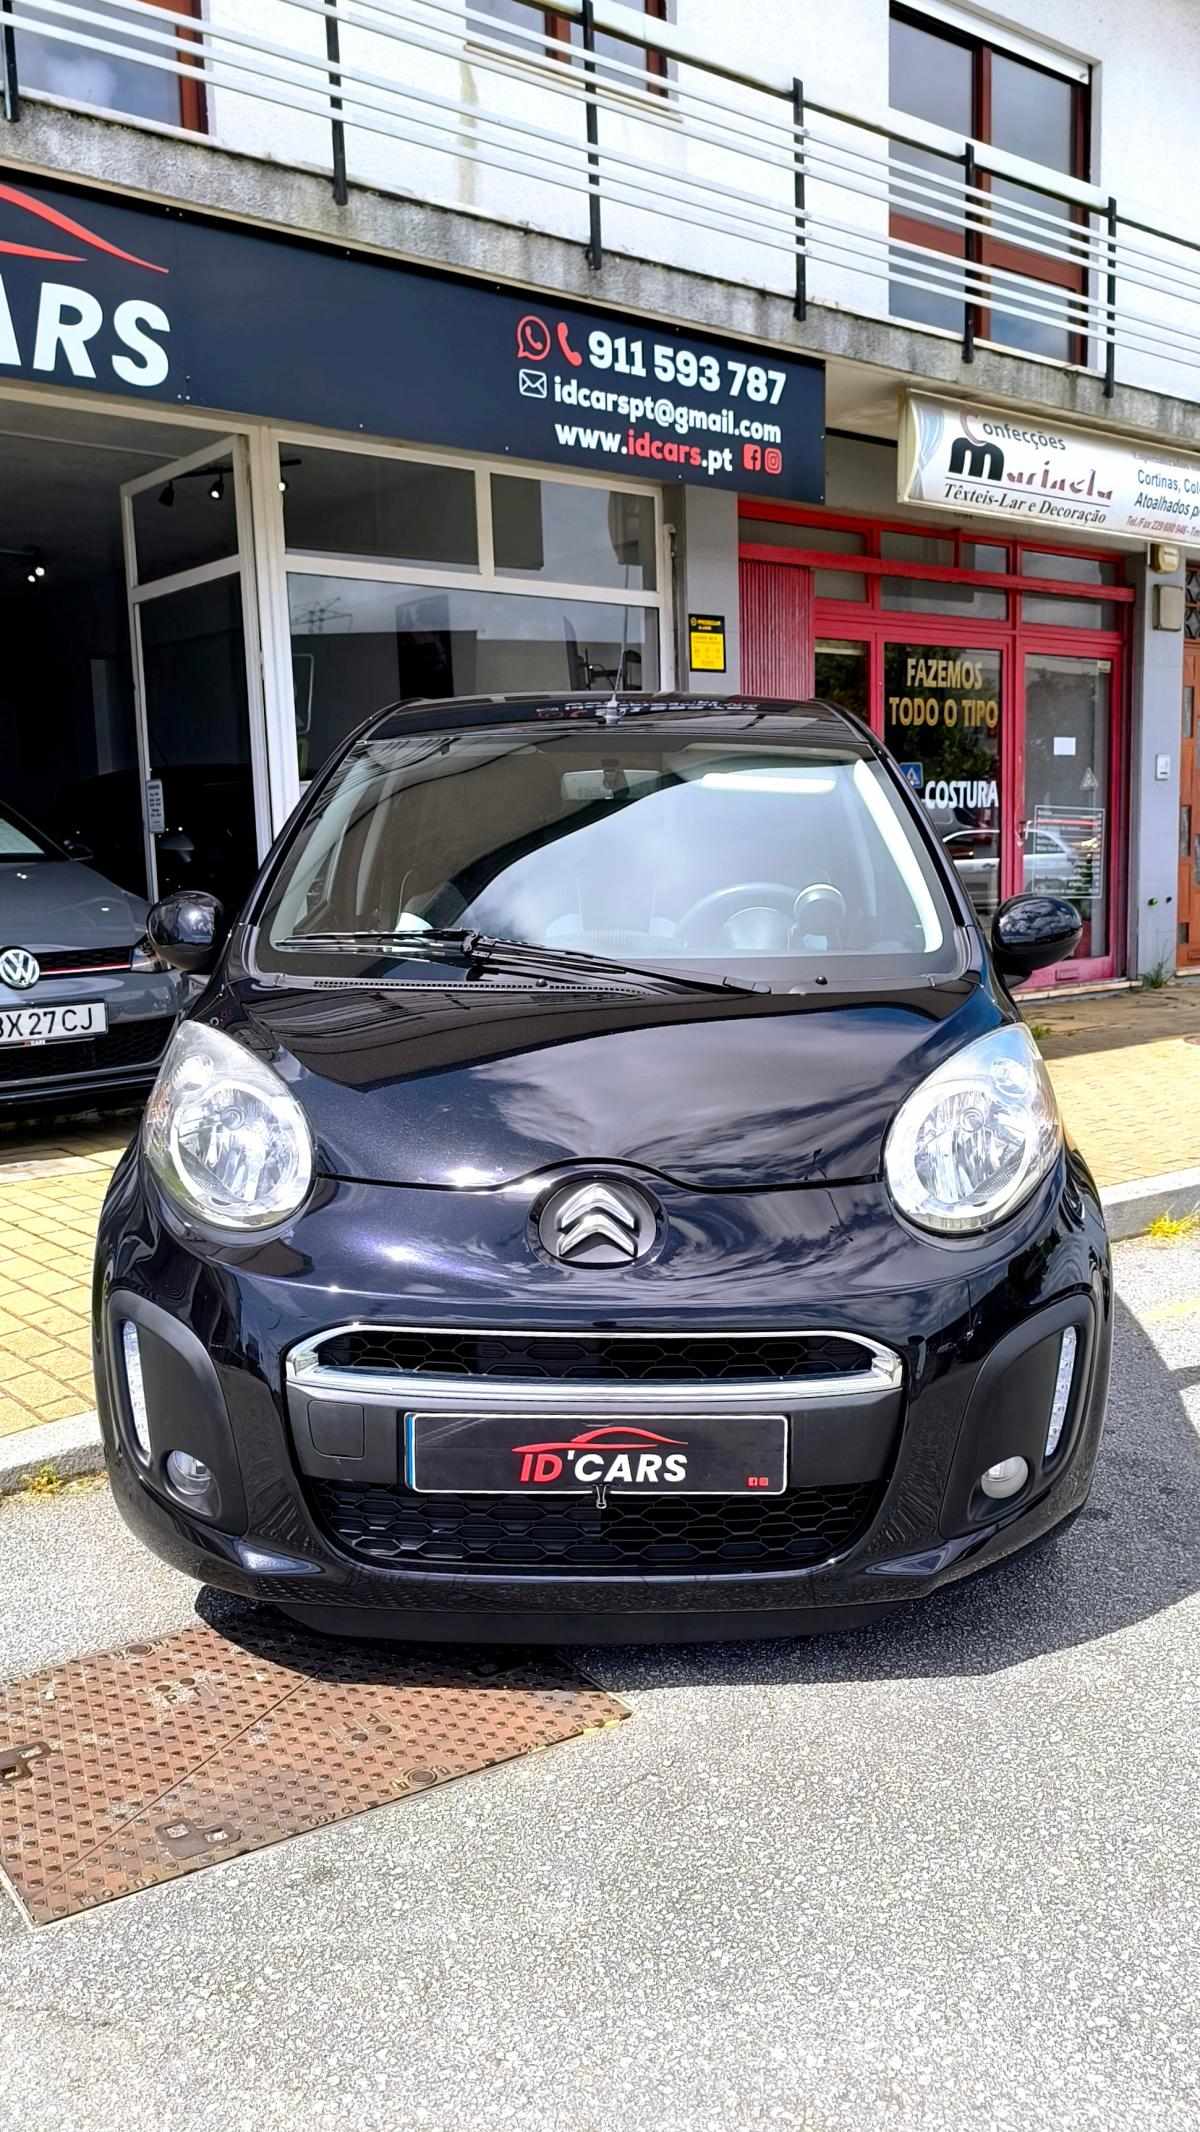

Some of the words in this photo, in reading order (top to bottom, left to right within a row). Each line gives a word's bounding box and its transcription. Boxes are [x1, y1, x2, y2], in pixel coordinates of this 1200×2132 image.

[588, 331, 646, 377] 911
[654, 345, 720, 391] 593
[727, 361, 786, 405] 787
[554, 376, 781, 443] idcarspt@gmail.com
[554, 424, 733, 475] www.idcars.pt
[1137, 469, 1181, 493] Cortinas,
[1183, 478, 1200, 495] Col
[944, 483, 1026, 511] Têxteis-Lar
[1039, 499, 1107, 524] Decoração
[1189, 505, 1200, 520] p
[906, 658, 983, 689] FAZEMOS
[889, 697, 939, 726] TODO
[944, 699, 957, 727] O
[961, 700, 998, 728] TIPO
[925, 780, 999, 809] COSTURA
[519, 1450, 687, 1483] ID'CARS
